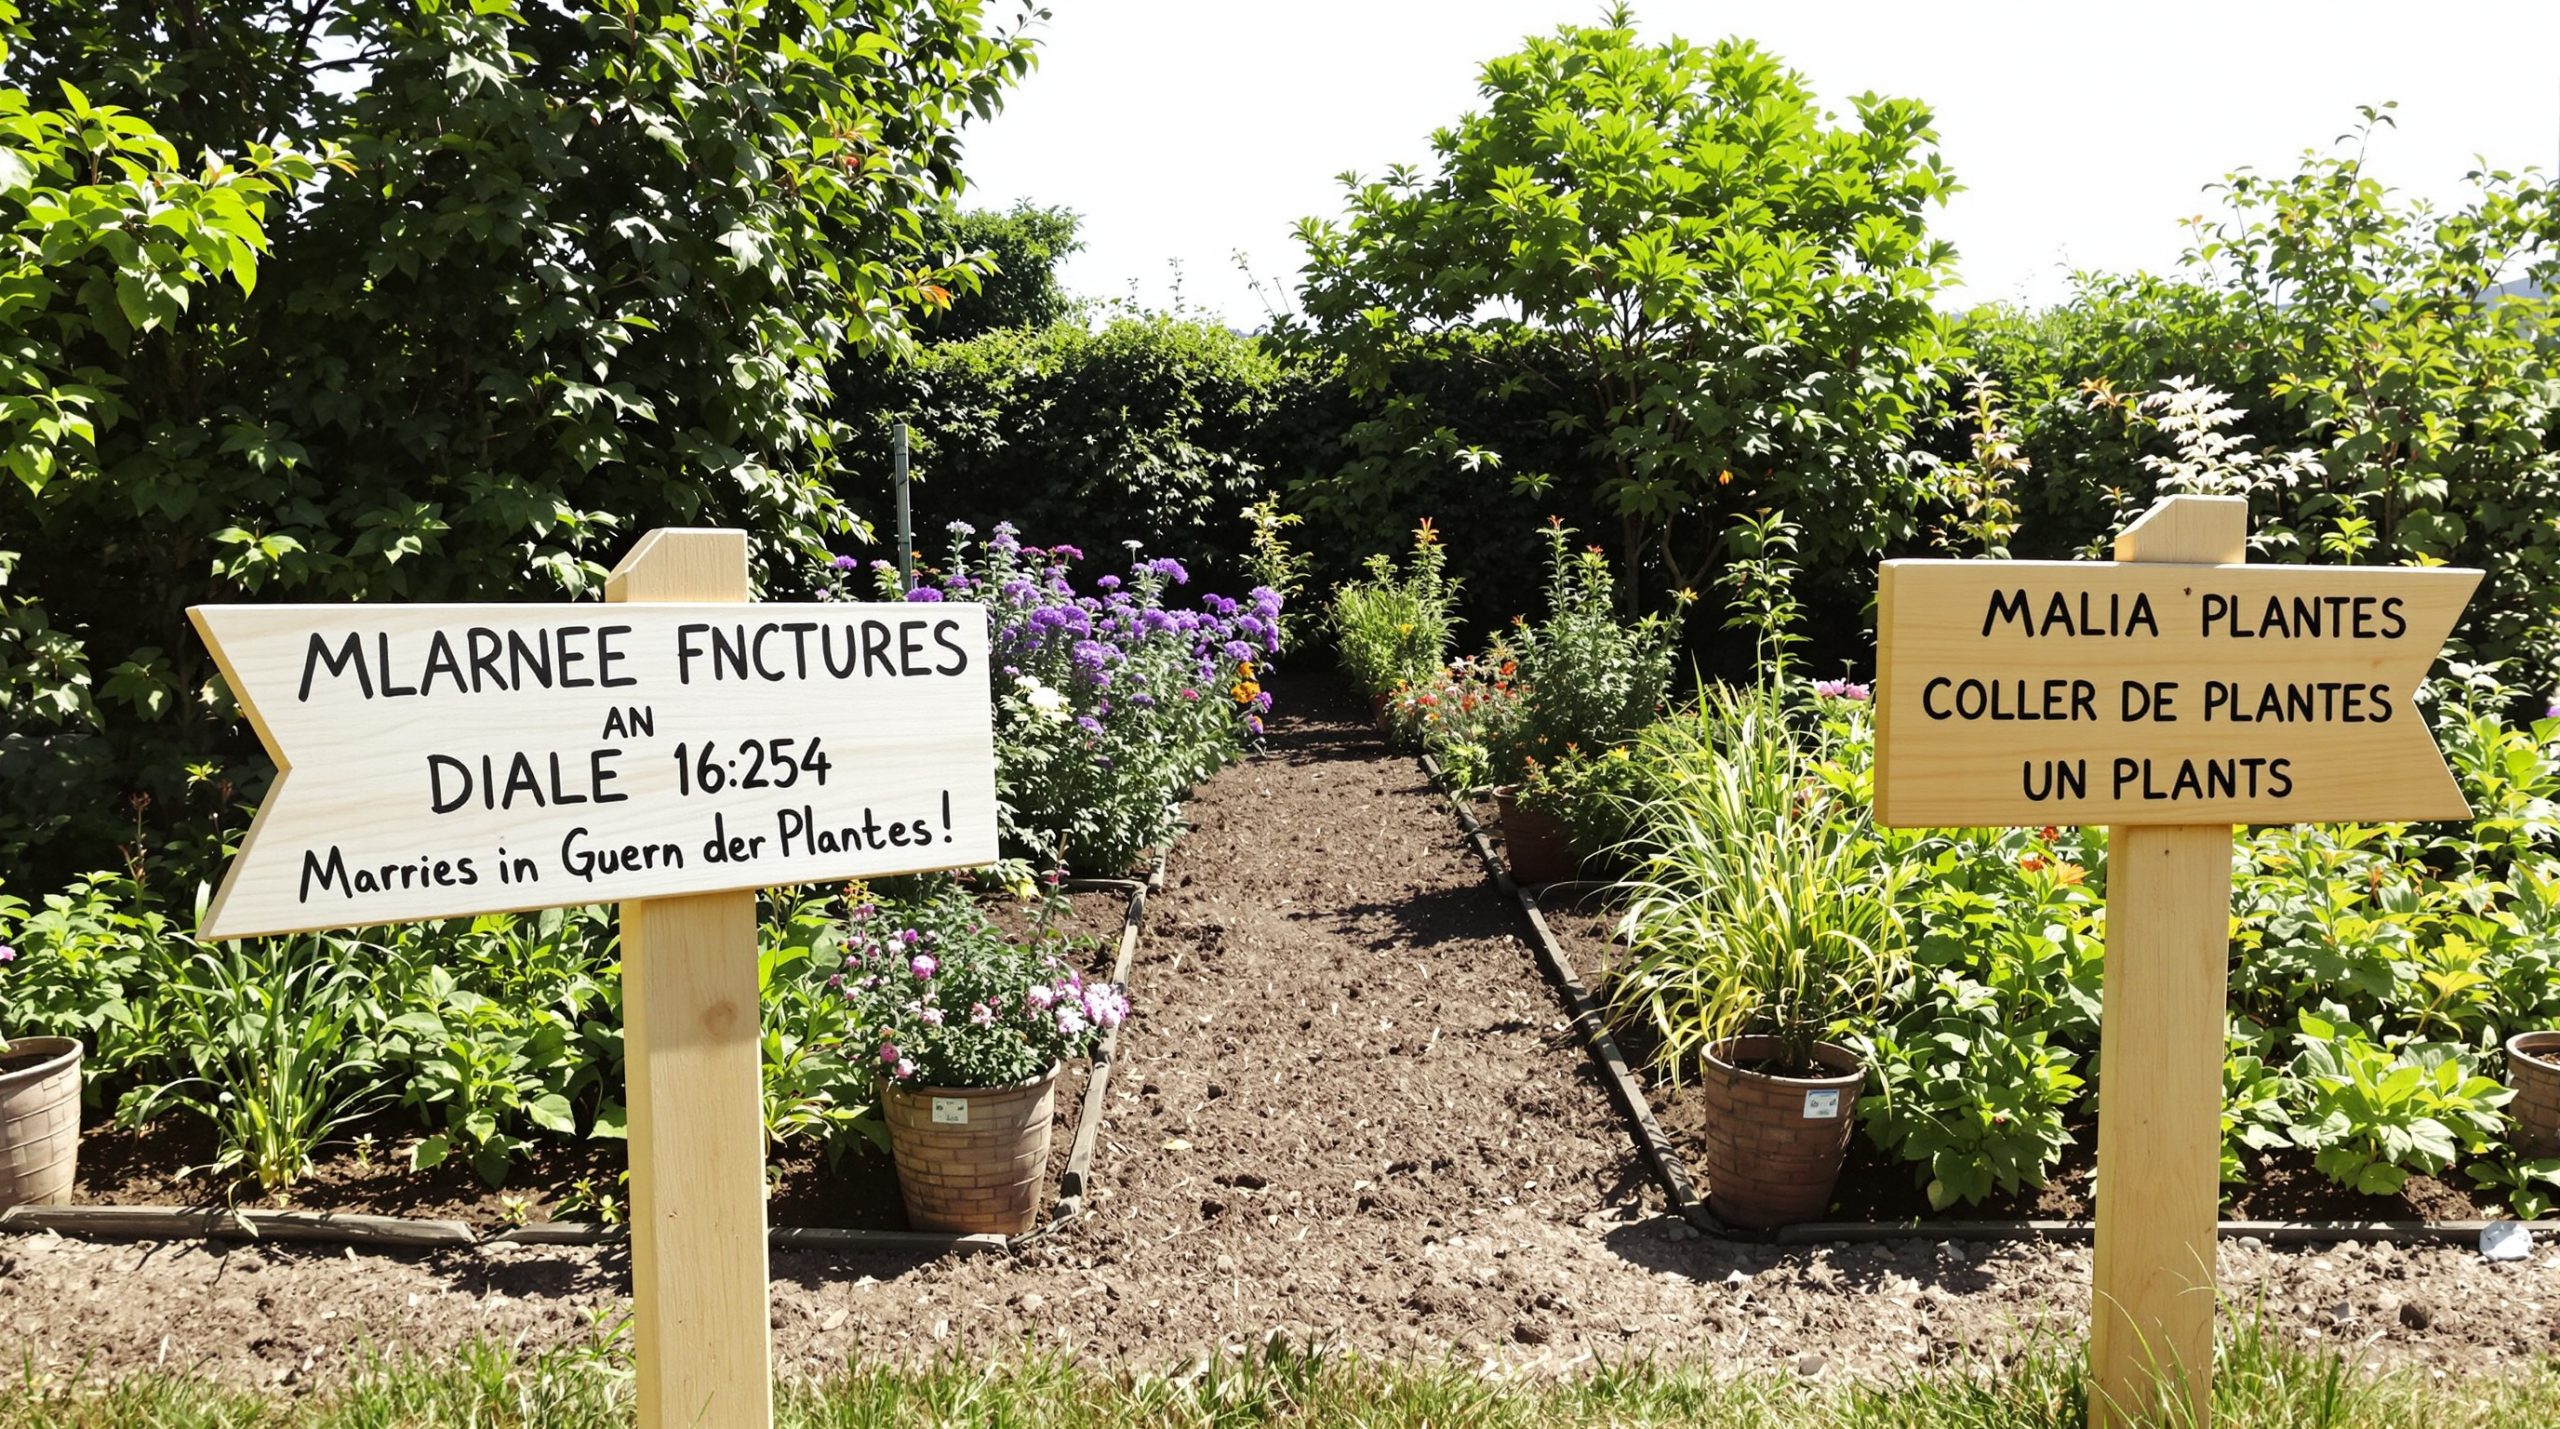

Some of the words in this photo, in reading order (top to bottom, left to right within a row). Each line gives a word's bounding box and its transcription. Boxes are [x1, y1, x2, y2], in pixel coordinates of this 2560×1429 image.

[1981, 588, 2159, 638] MALIA
[2202, 593, 2407, 640] PLANTES
[298, 625, 637, 703] MLARNEE
[678, 619, 968, 685] FNCTURES
[602, 705, 654, 740] AN
[1922, 676, 2098, 722] COLLER
[2121, 680, 2179, 723] DE
[2204, 680, 2393, 723] PLANTES
[426, 748, 628, 815] DIALE
[673, 736, 832, 796] 16:254
[2023, 758, 2086, 802] UN
[2113, 757, 2293, 801] PLANTS
[299, 845, 478, 904] Marries
[498, 847, 539, 885] in
[561, 827, 684, 883] Guern
[703, 812, 766, 863] der
[777, 790, 952, 858] Plantes!
